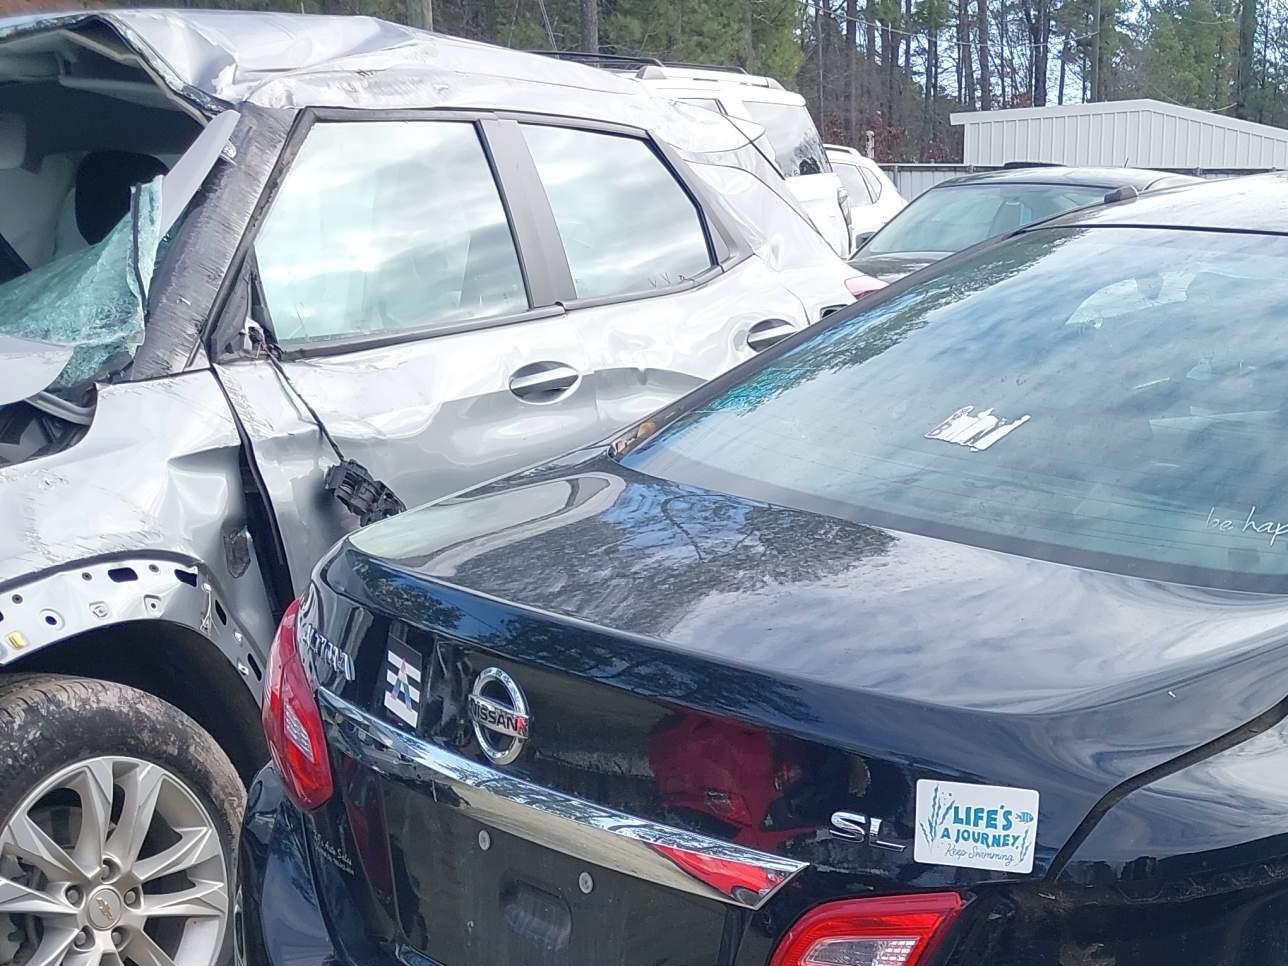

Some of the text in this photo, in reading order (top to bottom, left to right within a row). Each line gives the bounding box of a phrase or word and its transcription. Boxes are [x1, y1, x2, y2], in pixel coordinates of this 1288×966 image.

[1206, 507, 1234, 532] be
[471, 698, 518, 732] NISSAN
[953, 805, 1013, 832] LIFE'S
[829, 812, 906, 852] SL
[941, 827, 951, 840] A
[945, 843, 968, 859] Keep
